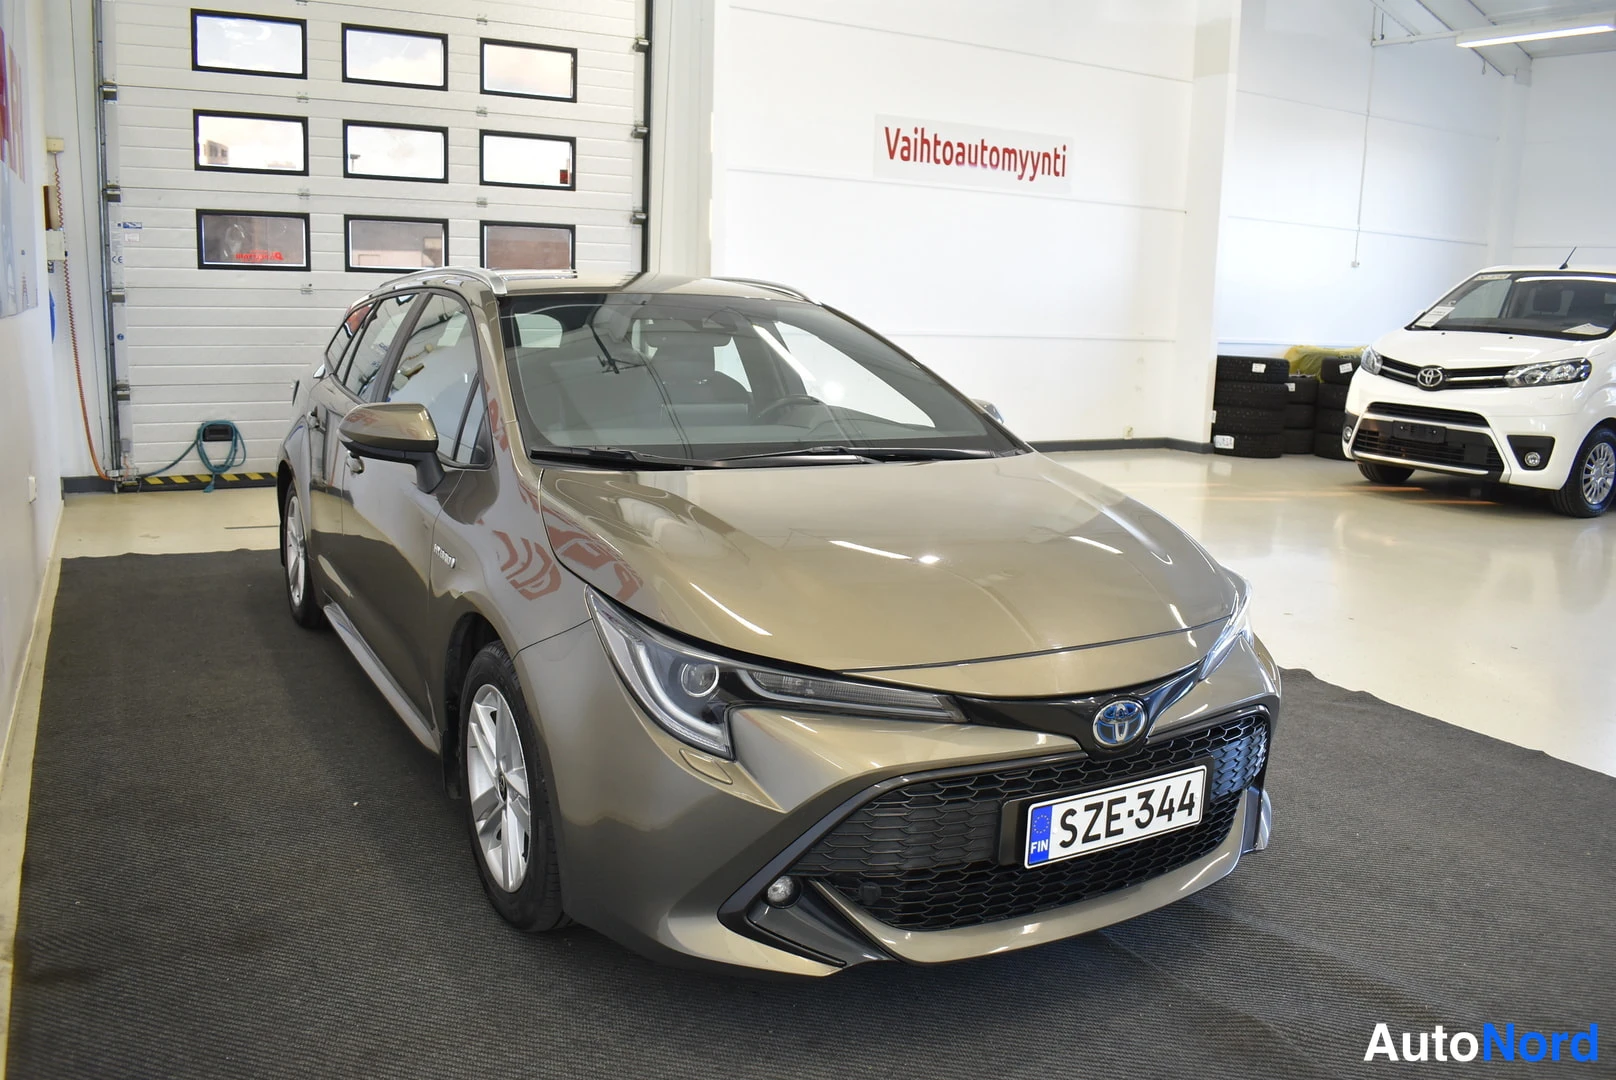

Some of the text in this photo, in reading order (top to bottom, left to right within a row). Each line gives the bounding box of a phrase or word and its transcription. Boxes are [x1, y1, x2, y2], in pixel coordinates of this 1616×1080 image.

[884, 126, 1067, 182] Vaihtoautomyynti
[1059, 780, 1196, 848] SZE-344
[1030, 839, 1049, 855] FIN
